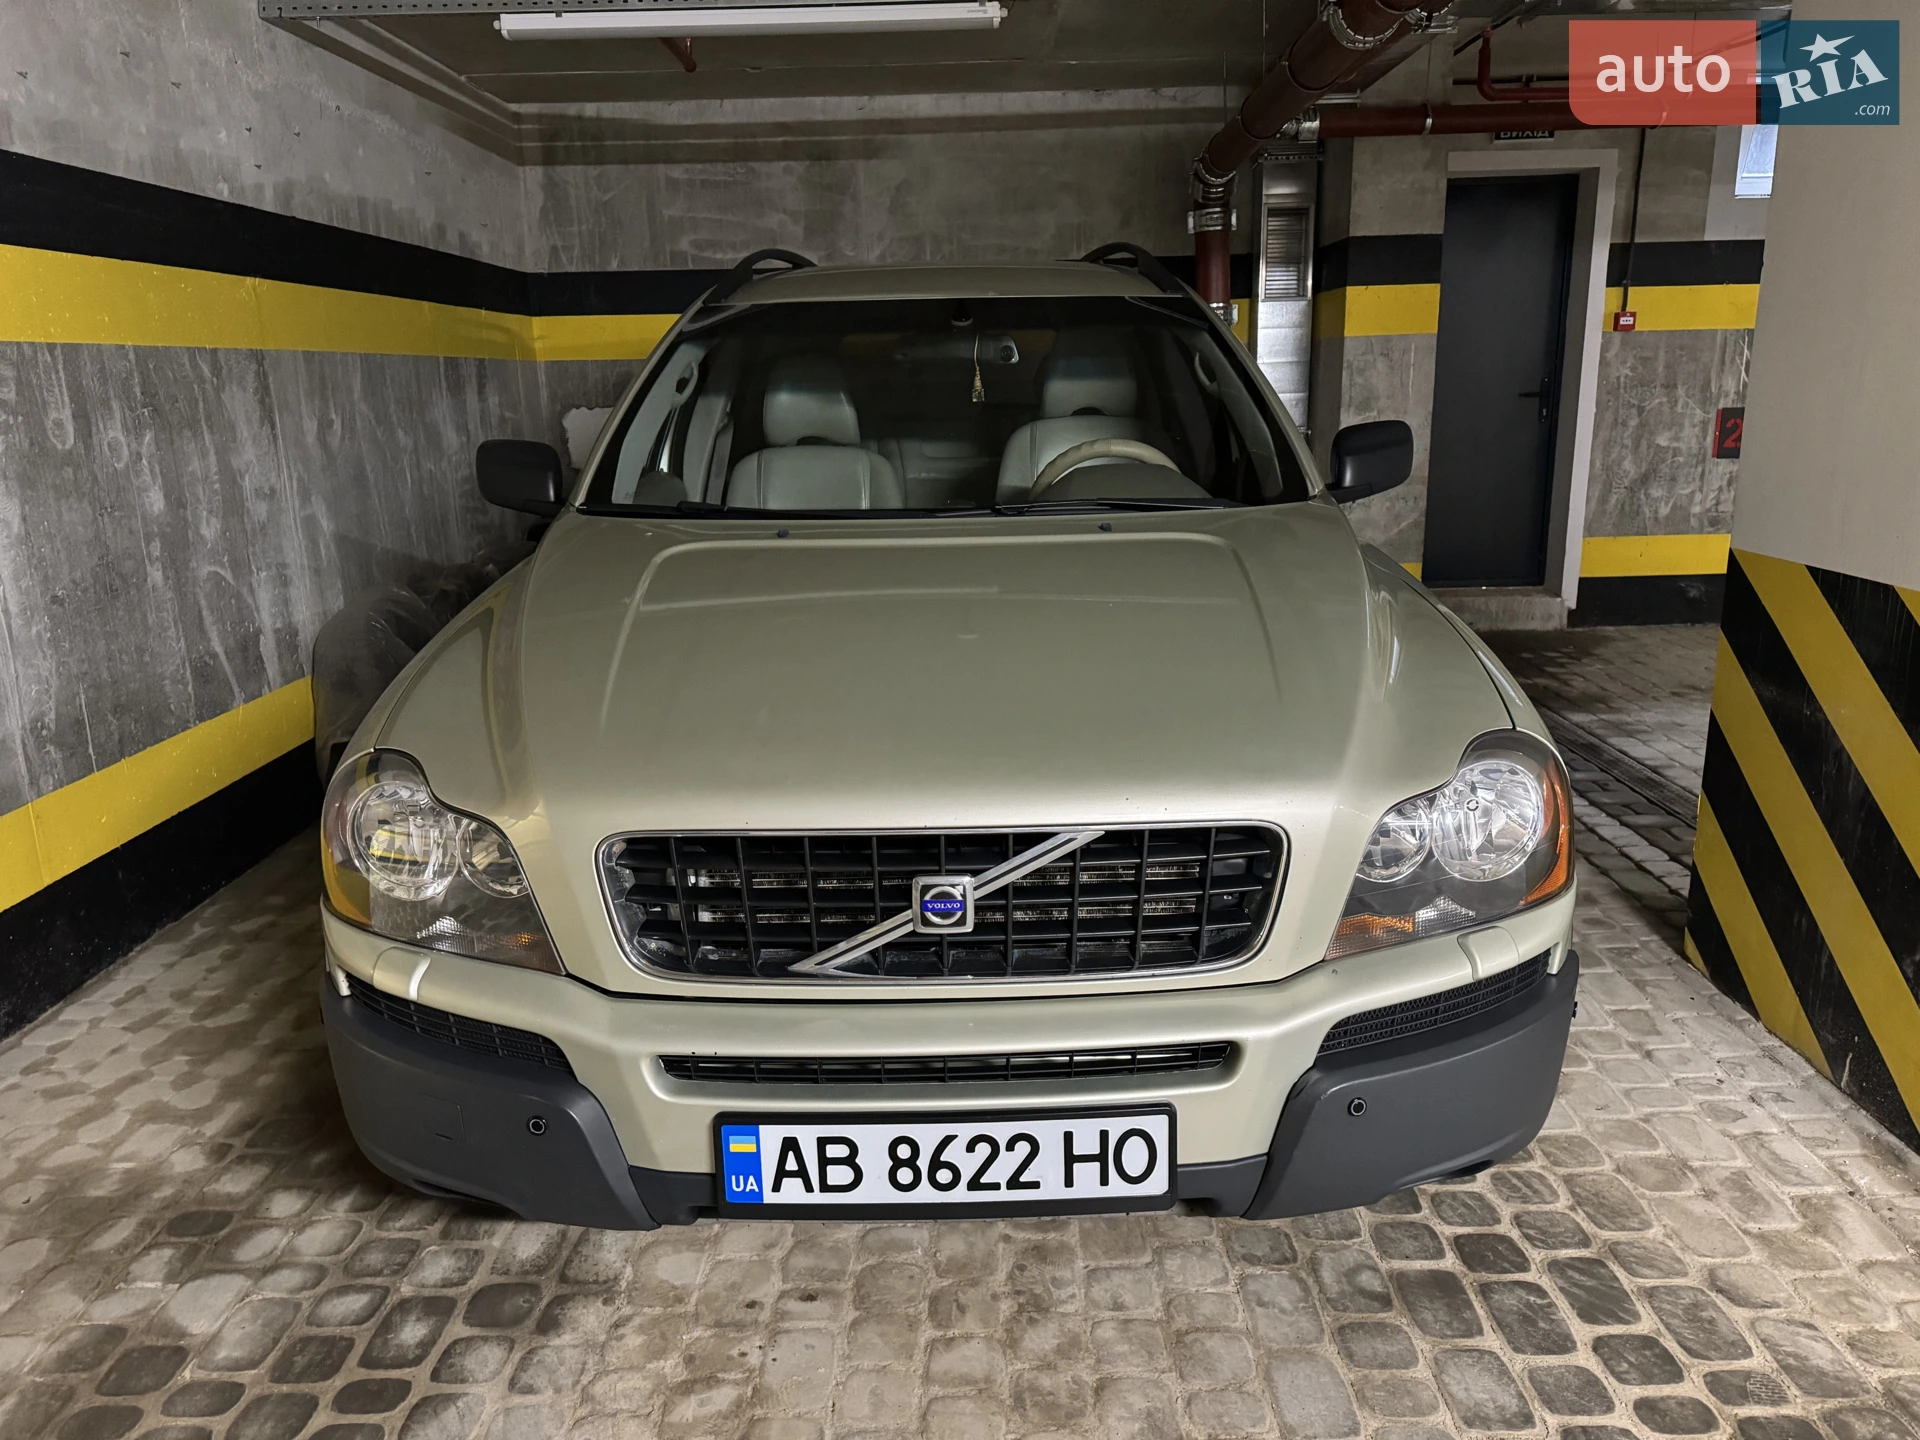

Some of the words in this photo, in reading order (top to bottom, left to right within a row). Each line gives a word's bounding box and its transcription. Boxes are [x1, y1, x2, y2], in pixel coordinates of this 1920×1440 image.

[771, 1136, 864, 1193] AB
[888, 1132, 1041, 1192] 8622
[1063, 1128, 1158, 1188] HO
[731, 1174, 759, 1192] UA
